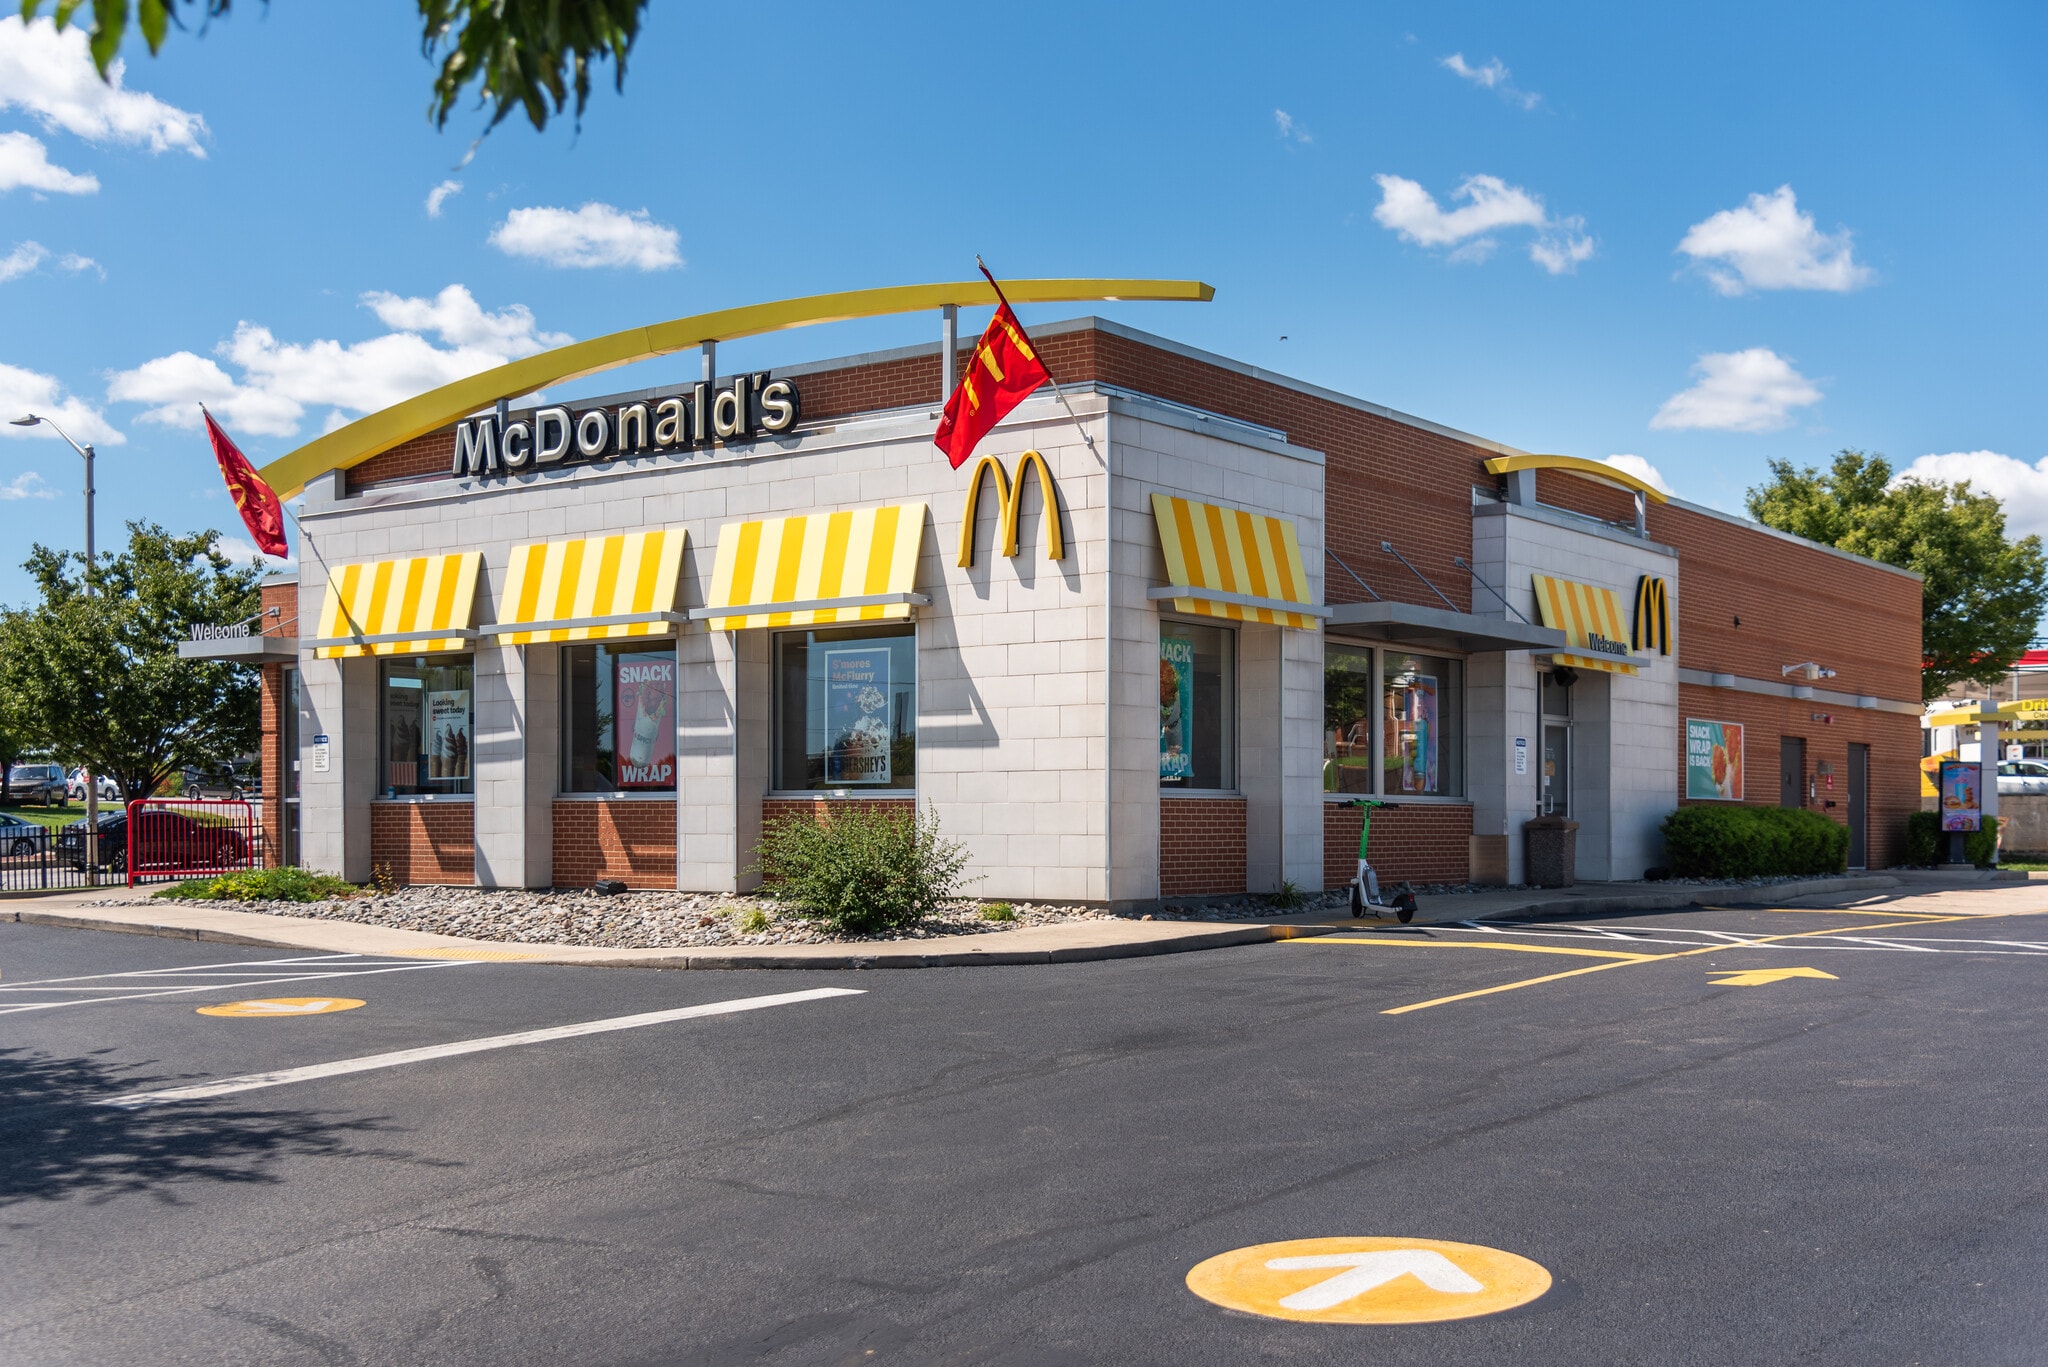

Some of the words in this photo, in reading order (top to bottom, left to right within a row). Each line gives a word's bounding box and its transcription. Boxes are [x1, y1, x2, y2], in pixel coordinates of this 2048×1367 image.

[453, 372, 799, 476] McDonald's
[191, 622, 250, 640] Welcome
[1161, 643, 1191, 663] NACK
[1588, 632, 1628, 656] Welcome
[620, 664, 672, 684] SNACK
[832, 671, 875, 683] McFlurry
[432, 698, 455, 708] Looking
[432, 707, 450, 715] sweet
[451, 706, 466, 715] today
[1689, 724, 1711, 739] SNACK
[1689, 738, 1711, 755] WRAP
[1161, 752, 1189, 772] RAP
[1689, 755, 1695, 767] IS
[1695, 755, 1711, 767] BACK
[621, 764, 672, 783] WRAP
